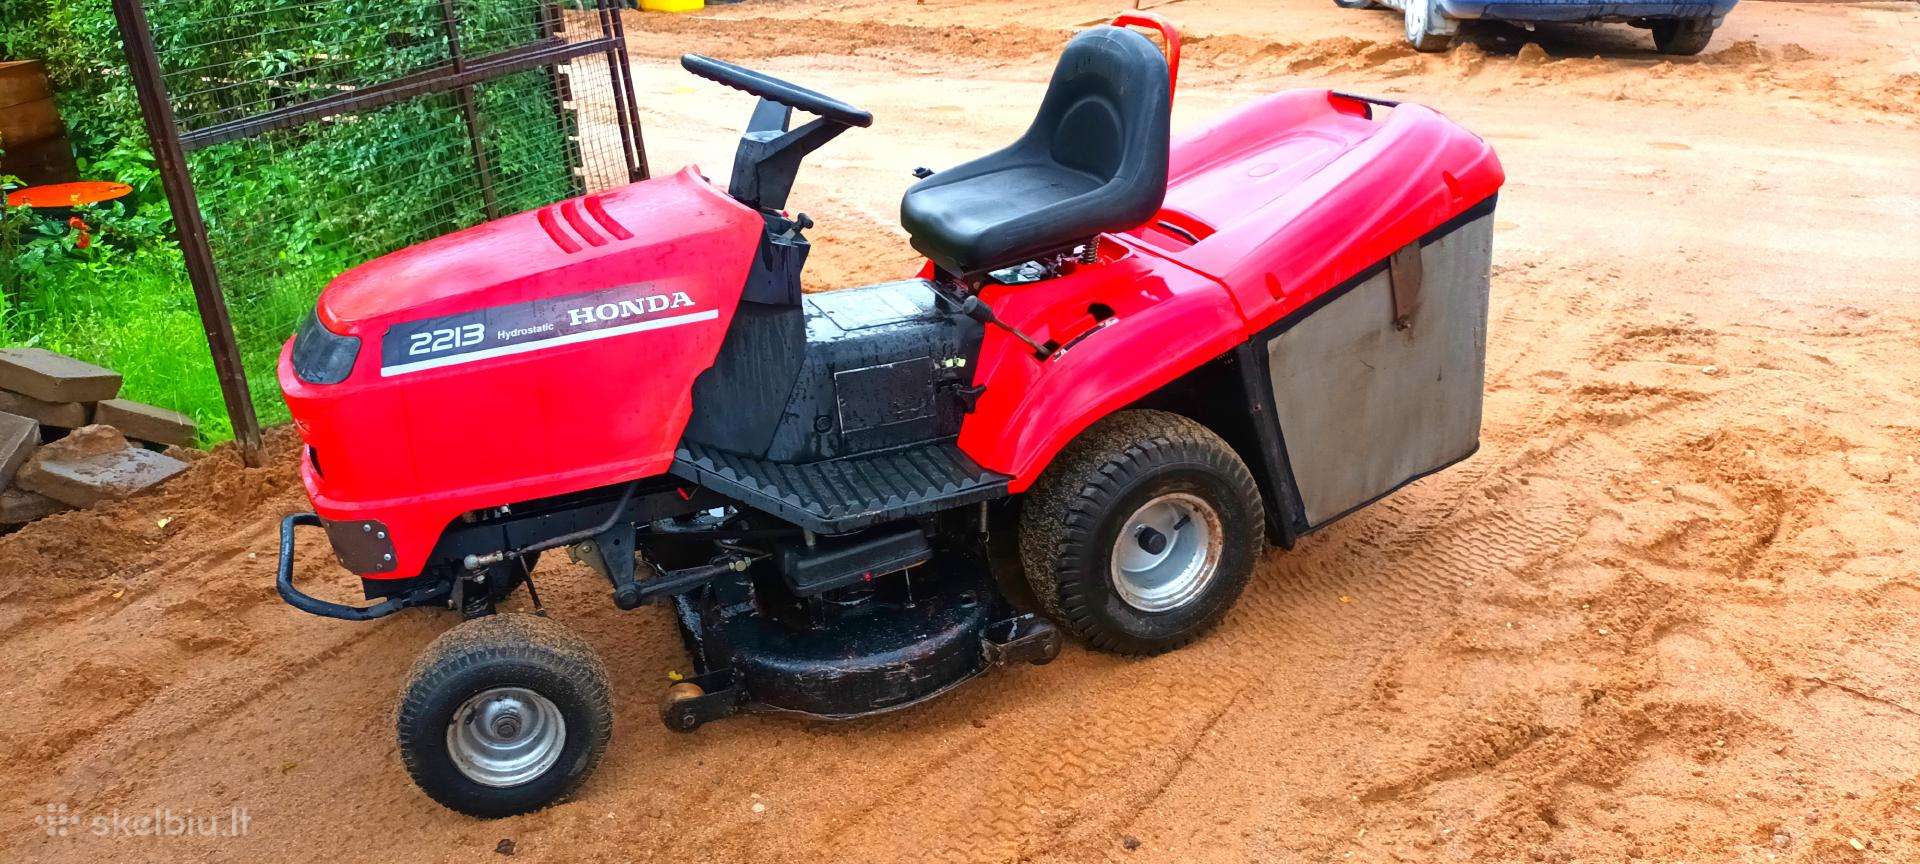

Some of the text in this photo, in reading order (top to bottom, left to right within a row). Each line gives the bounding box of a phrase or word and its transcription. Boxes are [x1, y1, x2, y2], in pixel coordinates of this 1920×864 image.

[409, 291, 695, 356] 2213 Hydrostatic HONDA
